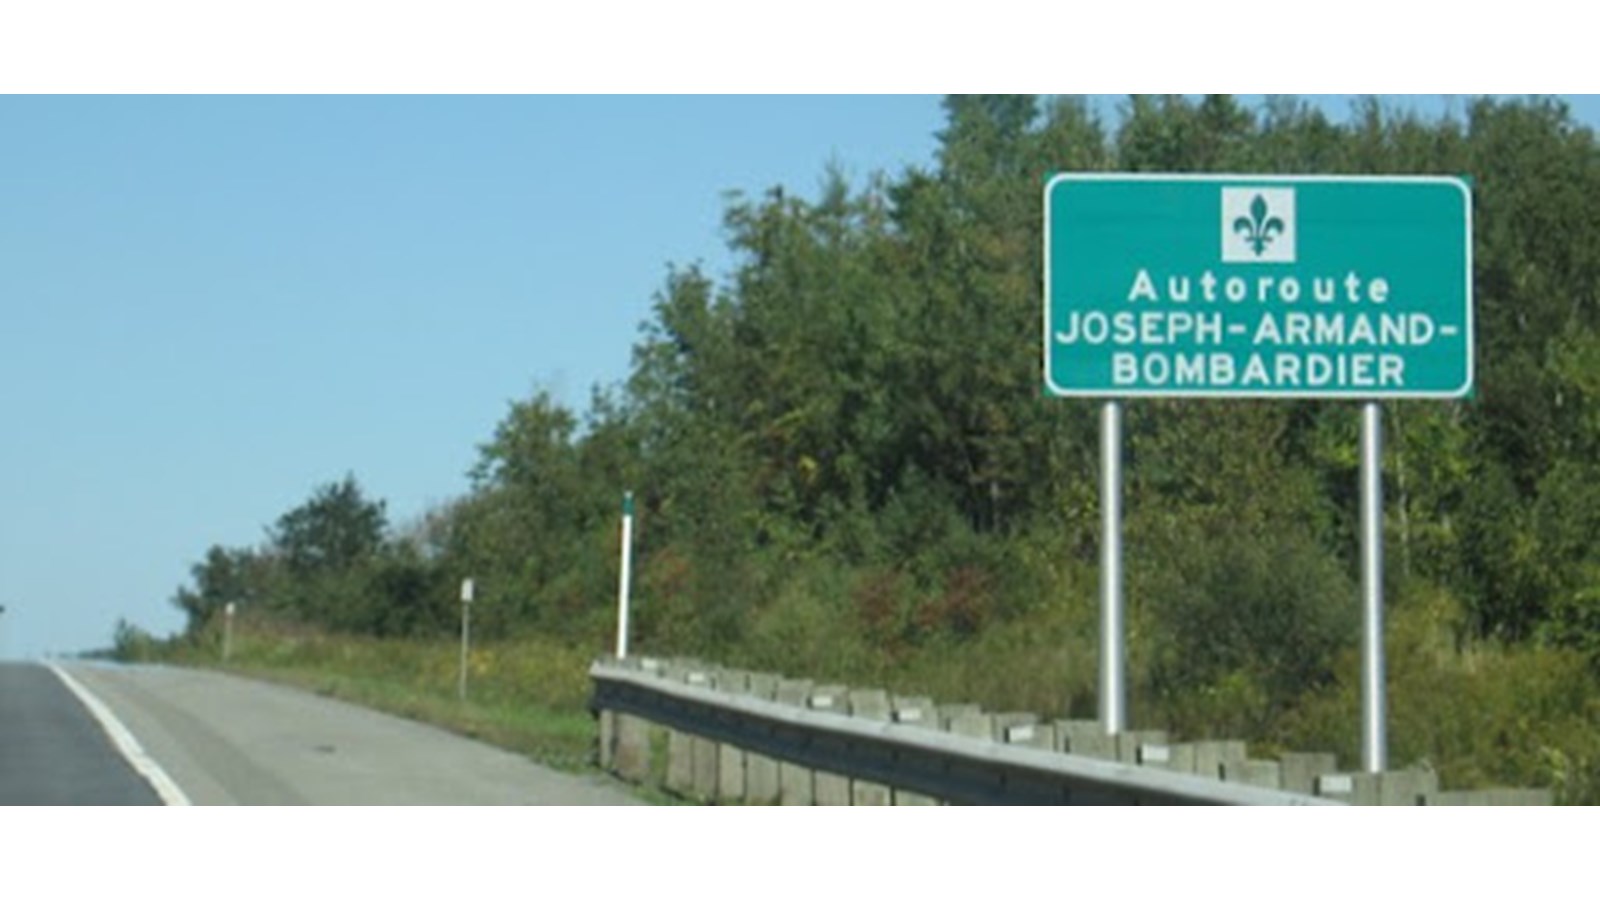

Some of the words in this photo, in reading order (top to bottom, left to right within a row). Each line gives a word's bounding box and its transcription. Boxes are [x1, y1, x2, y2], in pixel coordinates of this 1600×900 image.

[1128, 269, 1390, 302] Autoroute
[1055, 311, 1458, 345] JOSEPH-ARMAND-
[1112, 352, 1405, 385] BOMBARDIER
